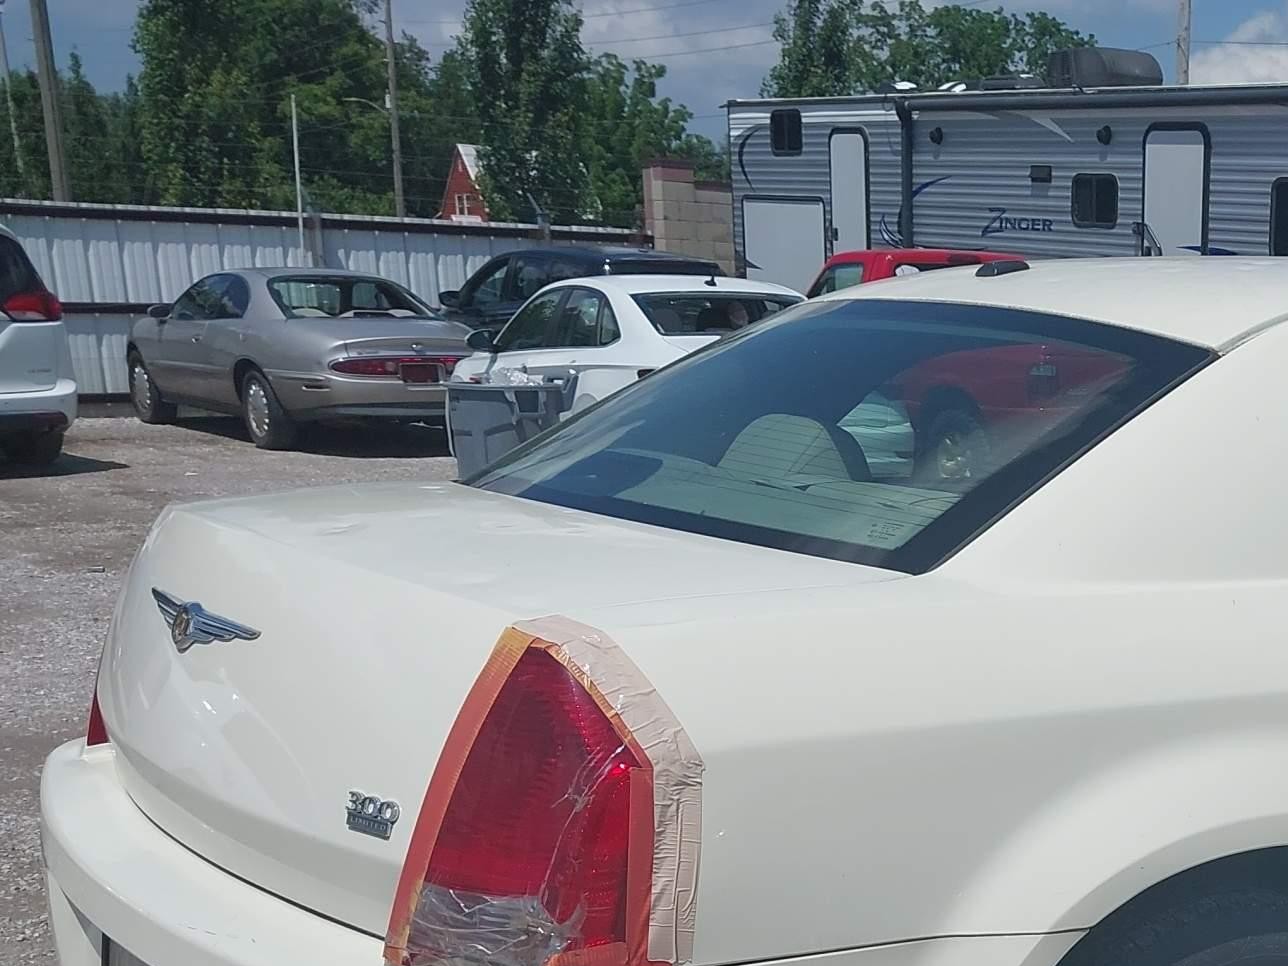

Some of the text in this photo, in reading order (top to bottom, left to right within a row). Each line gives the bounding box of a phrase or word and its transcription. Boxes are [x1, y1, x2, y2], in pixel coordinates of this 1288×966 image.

[981, 206, 1054, 238] ZINGER
[345, 791, 400, 824] 300
[350, 815, 387, 831] LIMITED
